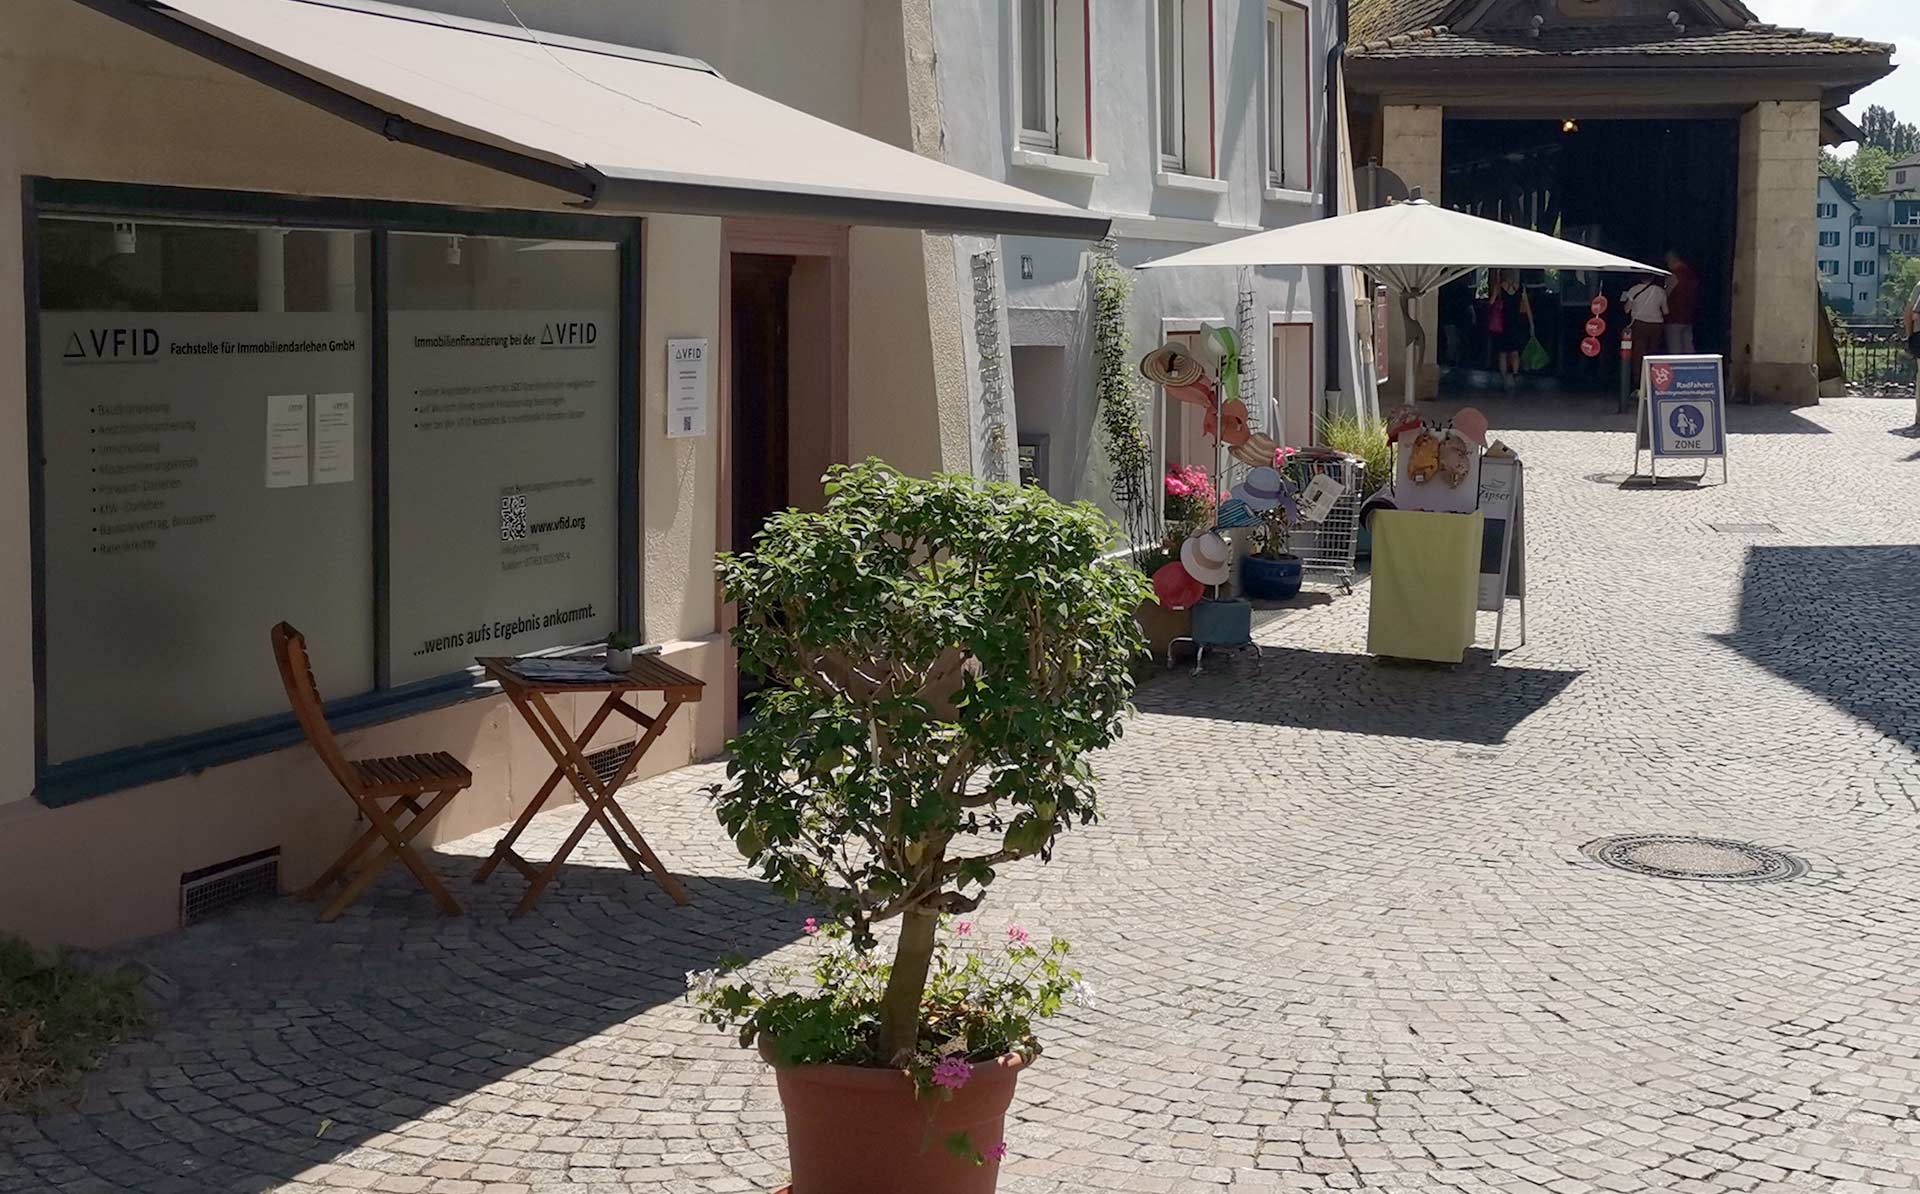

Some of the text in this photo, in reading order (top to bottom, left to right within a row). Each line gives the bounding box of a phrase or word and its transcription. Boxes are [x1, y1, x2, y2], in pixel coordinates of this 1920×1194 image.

[414, 333, 536, 348] Immobilienfinanzierung bei der
[556, 322, 597, 345] VFID
[89, 328, 160, 358] VFID
[170, 339, 356, 355] Fachstelle für Immobiliendarlehen GmbH
[682, 347, 702, 359] VFID
[1674, 440, 1702, 449] ZONE
[530, 516, 586, 534] www.vfid.org
[466, 624, 491, 644] aufs
[494, 614, 541, 640] Ergebnis
[543, 604, 597, 628] ankommt.
